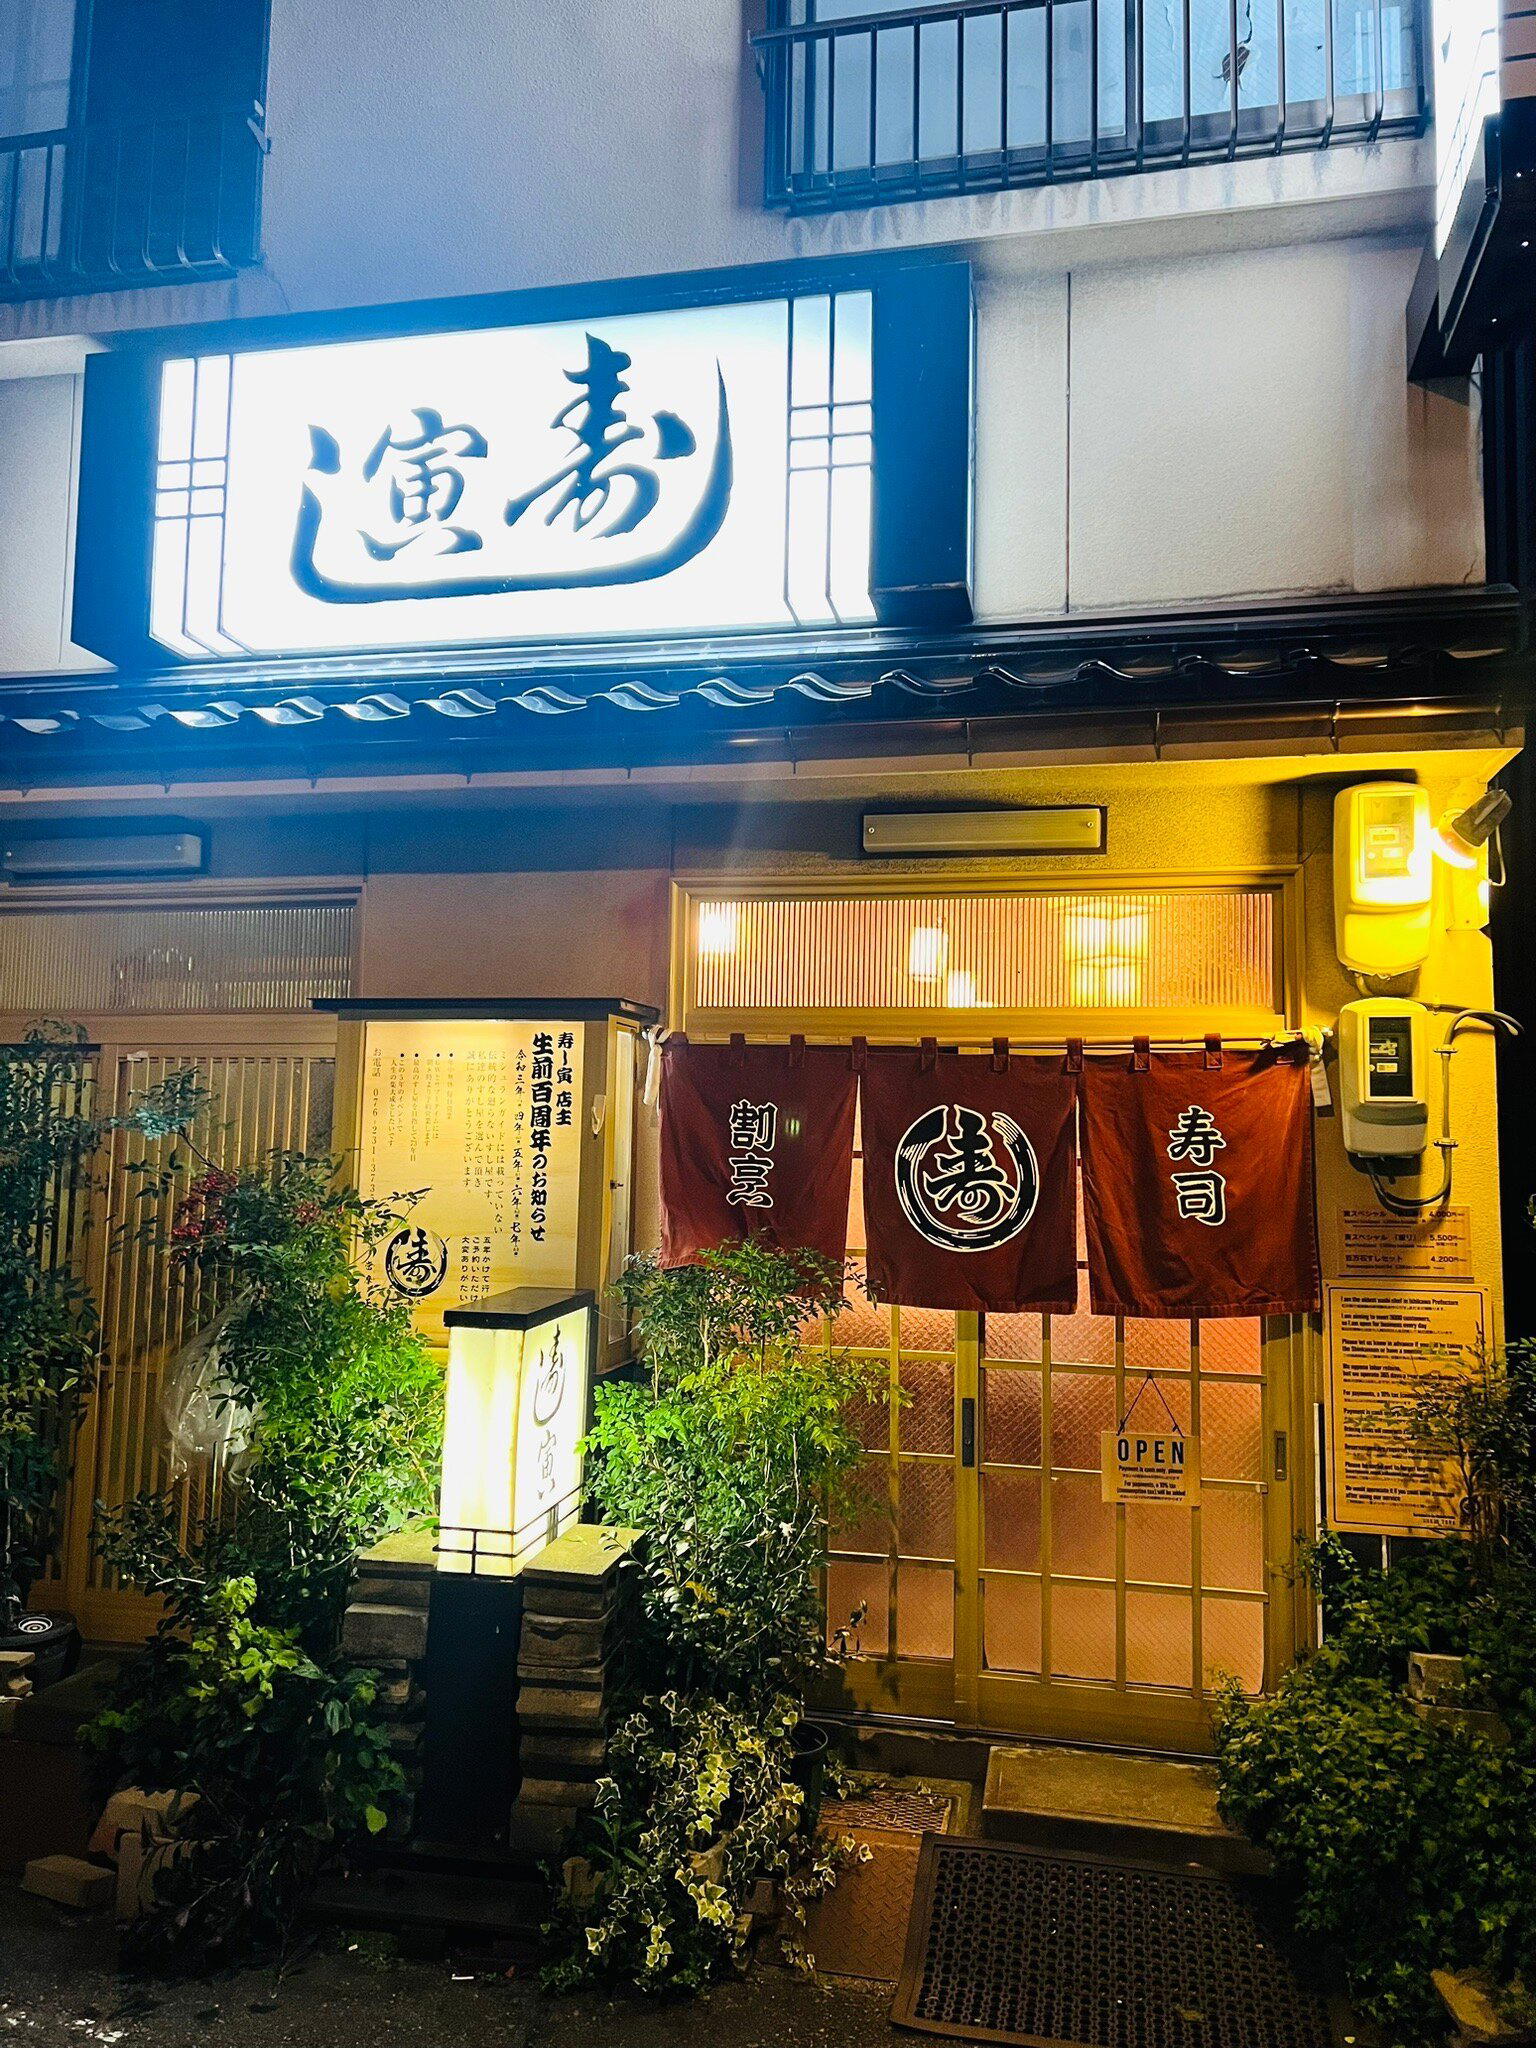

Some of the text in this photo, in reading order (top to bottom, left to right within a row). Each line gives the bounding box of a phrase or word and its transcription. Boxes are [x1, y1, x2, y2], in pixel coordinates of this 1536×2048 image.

[555, 1031, 575, 1126] 寿し寅 店主
[529, 1032, 555, 1243] 生前百周年のお知らせ
[725, 1098, 777, 1209] 割烹
[1165, 1104, 1228, 1227] 寿司
[1118, 1438, 1184, 1464] OPEN
